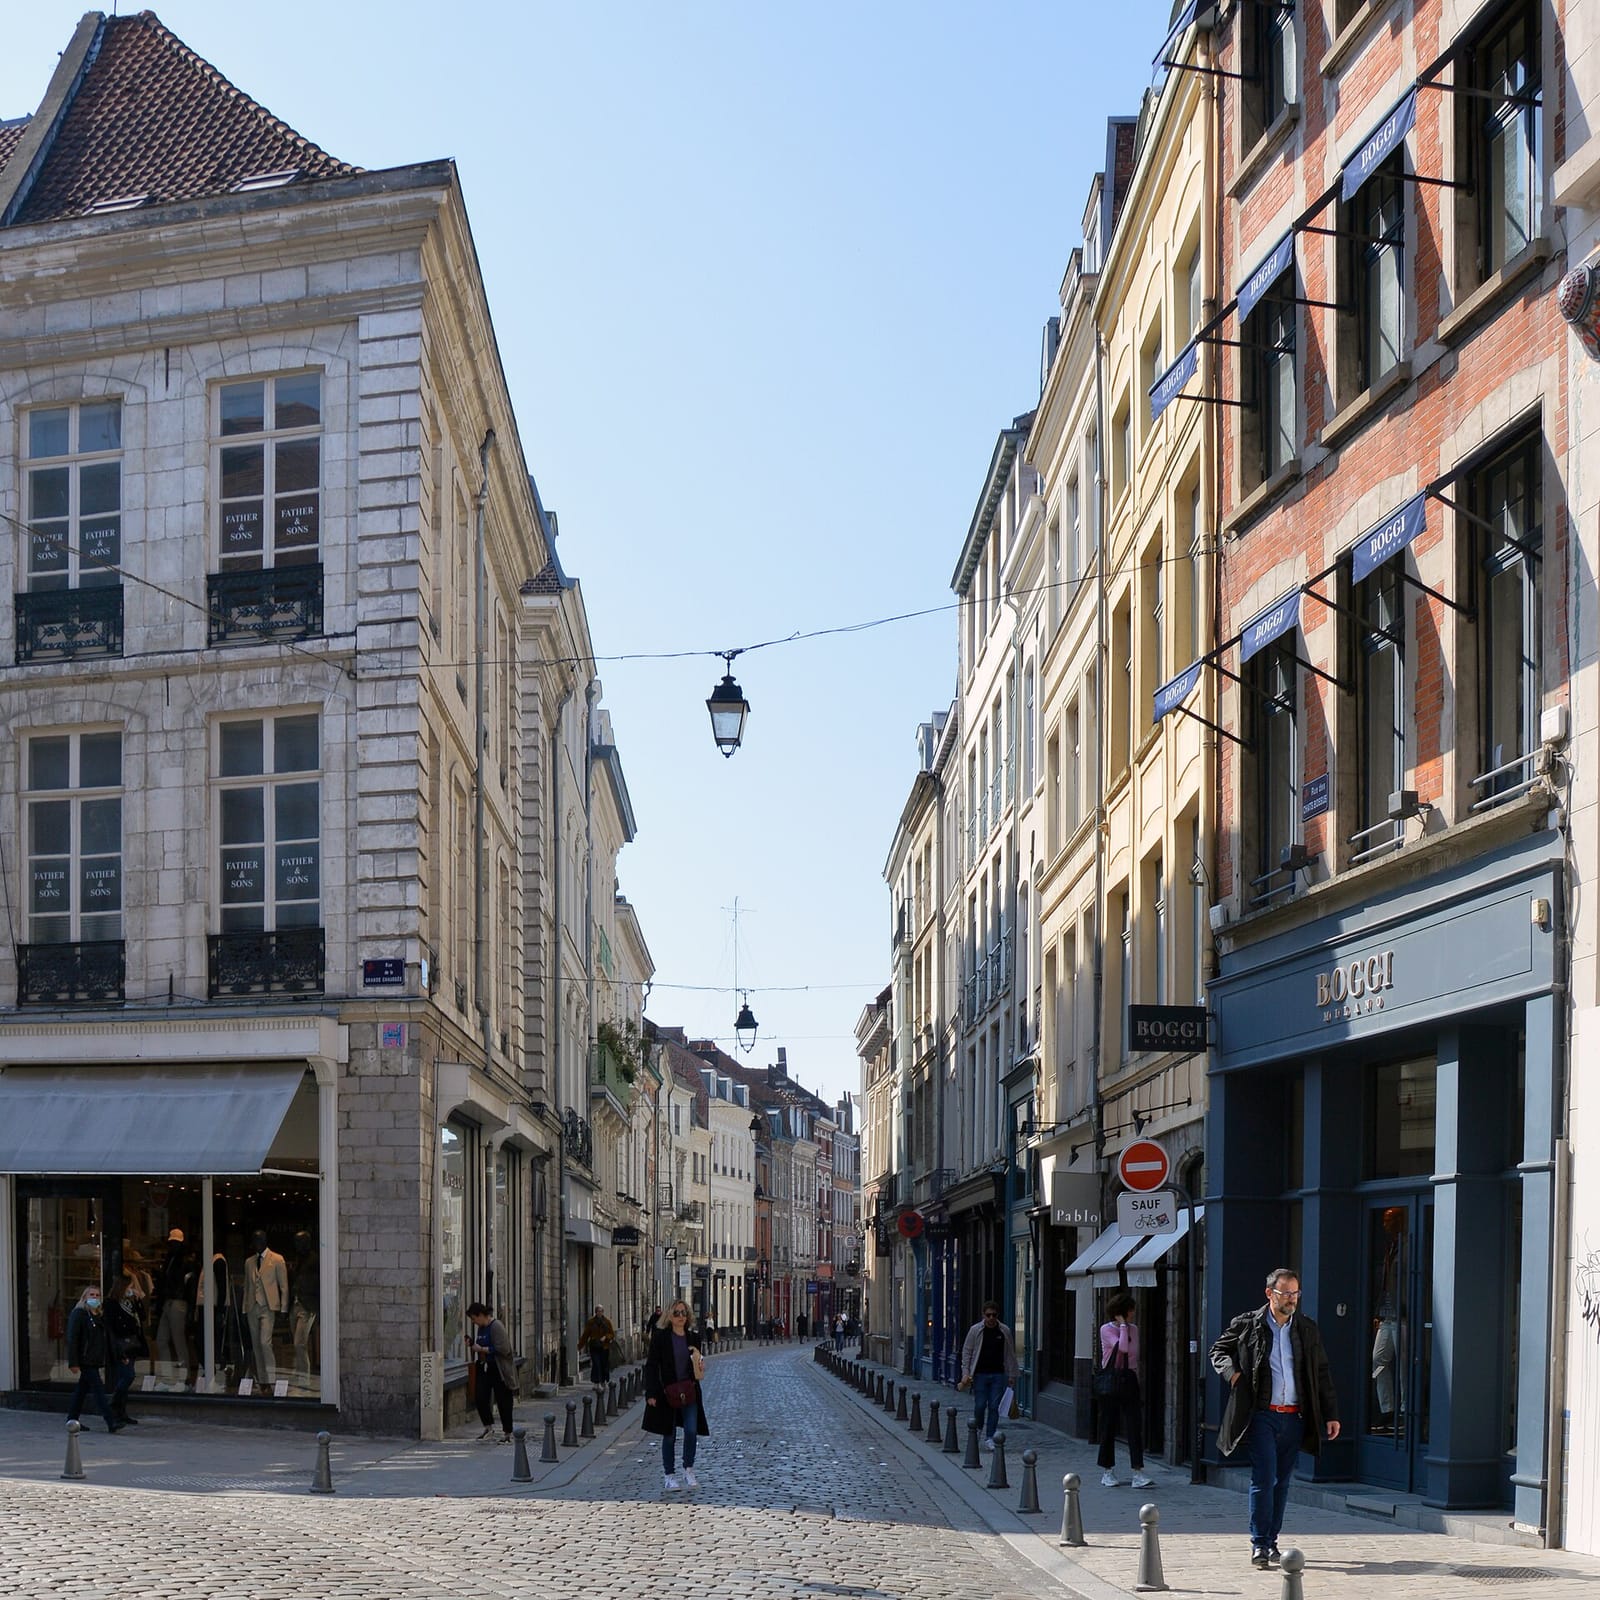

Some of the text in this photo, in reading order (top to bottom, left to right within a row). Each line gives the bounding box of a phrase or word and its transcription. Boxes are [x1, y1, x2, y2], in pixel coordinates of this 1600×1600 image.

[1360, 116, 1397, 170] BOGGI
[1250, 253, 1278, 297] BOGGI
[1161, 362, 1185, 398] BOGGI
[281, 506, 314, 518] FATHER
[225, 512, 258, 524] FATHER
[85, 529, 115, 540] FATHER
[230, 531, 253, 541] SONS
[286, 525, 309, 536] SONS
[1370, 514, 1406, 557] BOGGI
[37, 551, 58, 561] SONS
[90, 547, 111, 557] SONS
[1254, 608, 1284, 641] BOGGI
[1164, 677, 1188, 705] BOGGI
[226, 861, 259, 871] FATHER
[281, 856, 314, 867] FATHER
[34, 871, 65, 880] FATHER
[86, 869, 116, 880] FATHER
[286, 875, 309, 885] SONS
[230, 879, 254, 889] SONS
[39, 888, 60, 898] SONS
[90, 888, 111, 897] SONS
[1315, 950, 1394, 1007] BOGGI
[1136, 1020, 1204, 1038] BOGGI
[1131, 1199, 1161, 1210] SAUF
[1057, 1209, 1098, 1223] Pablo
